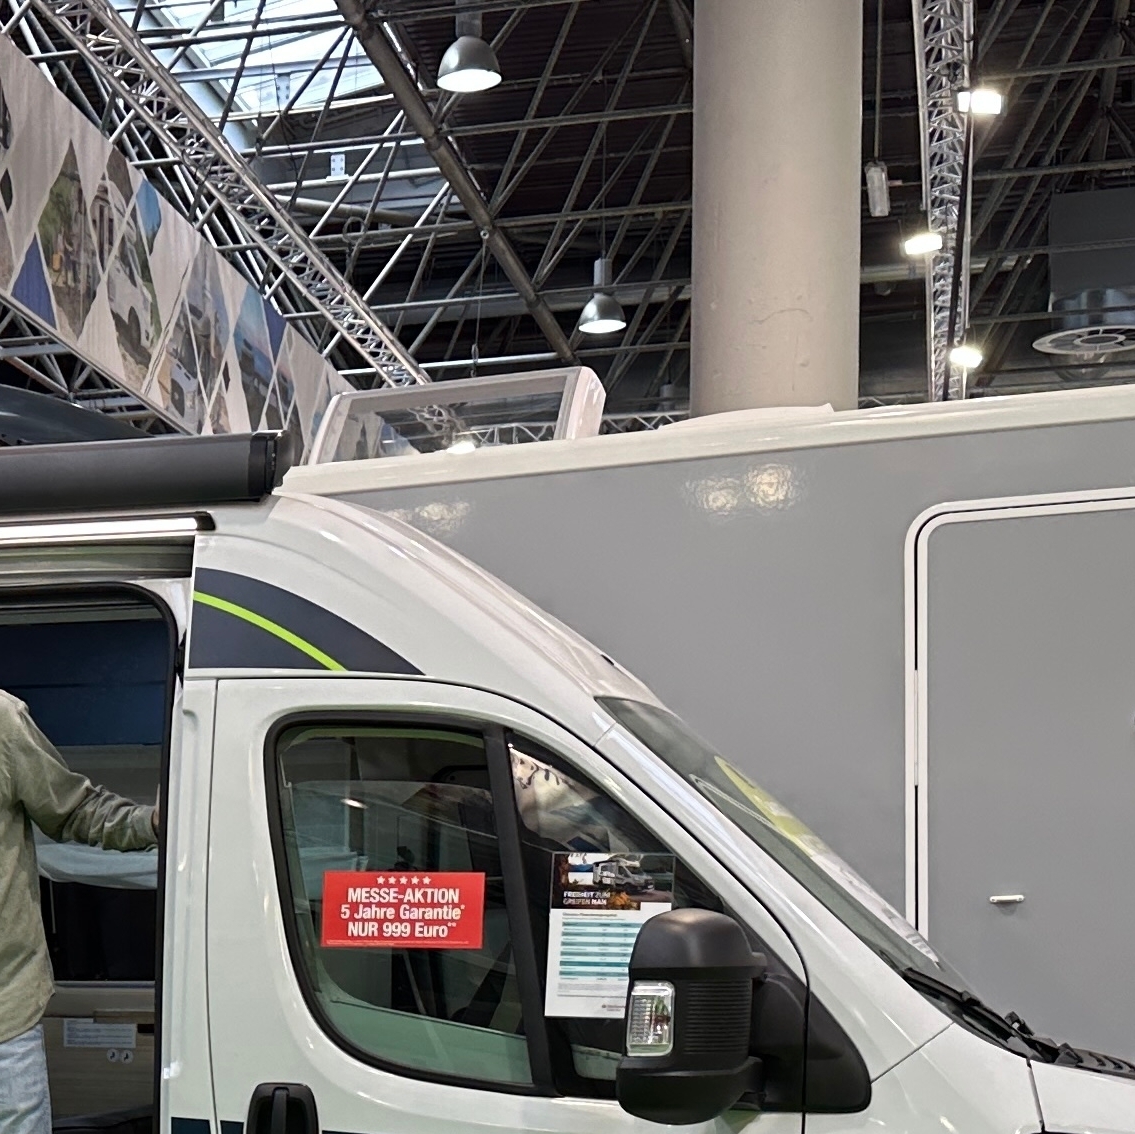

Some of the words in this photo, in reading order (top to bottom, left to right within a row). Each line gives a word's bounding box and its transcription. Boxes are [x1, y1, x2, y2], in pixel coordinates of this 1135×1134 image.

[347, 887, 460, 904] MESSE-AKTION
[340, 904, 351, 919] 5
[354, 904, 396, 919] Jahre
[347, 921, 379, 937] NUR
[382, 922, 411, 937] 999
